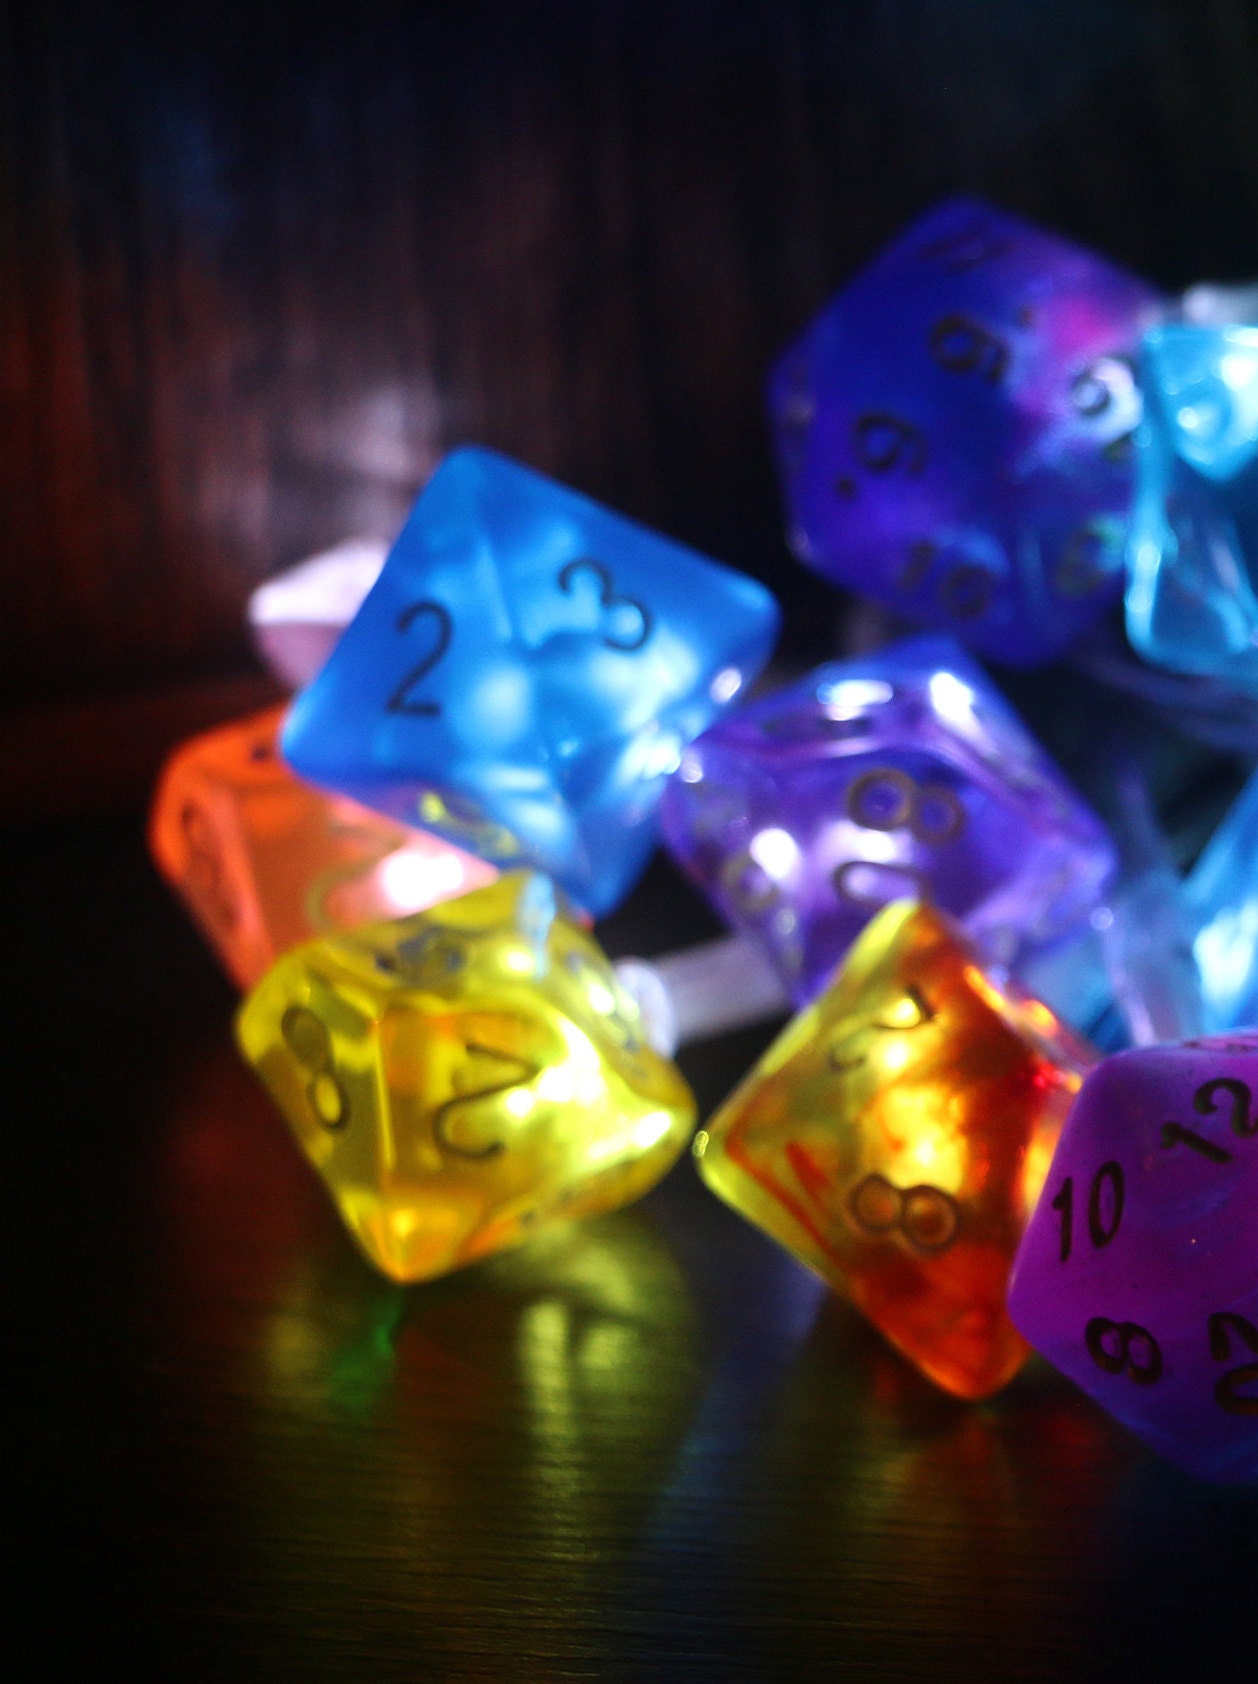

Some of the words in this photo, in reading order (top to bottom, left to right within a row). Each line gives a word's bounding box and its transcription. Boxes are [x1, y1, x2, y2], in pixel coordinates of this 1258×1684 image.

[557, 556, 653, 653] 3
[385, 600, 453, 720] 2
[280, 1004, 351, 1133] 8
[848, 1171, 958, 1257] 8
[1051, 1160, 1126, 1263] 10
[1084, 1316, 1164, 1387] 8
